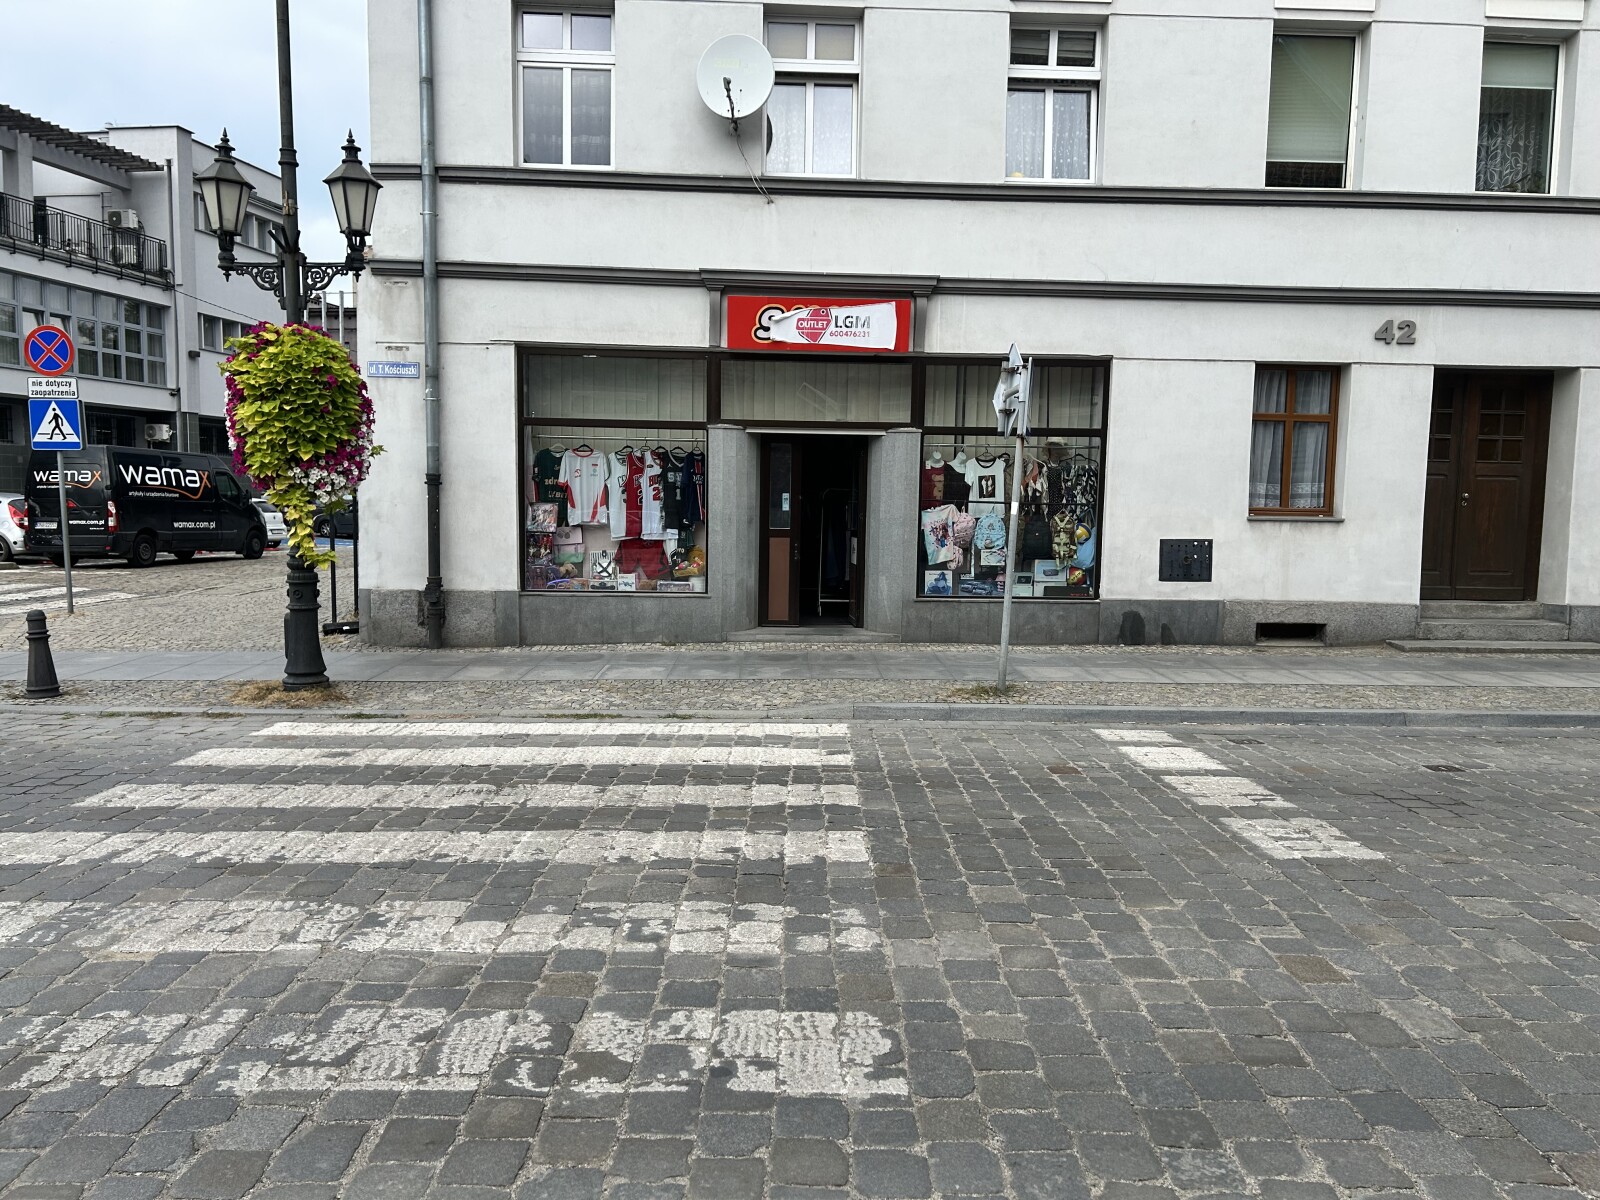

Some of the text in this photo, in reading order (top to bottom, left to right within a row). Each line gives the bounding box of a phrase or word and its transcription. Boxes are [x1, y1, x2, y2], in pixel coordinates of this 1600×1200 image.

[797, 320, 828, 329] OUTLET
[834, 315, 871, 329] LGM
[829, 330, 870, 338] 600476231
[1374, 319, 1416, 345] 42
[369, 364, 416, 374] ul. T. Kościuszki
[45, 379, 72, 388] dotyczy
[30, 388, 76, 397] zaopatrzenia
[33, 470, 102, 482] wamax
[119, 464, 212, 489] wamax
[173, 520, 216, 529] wamax.com.pl
